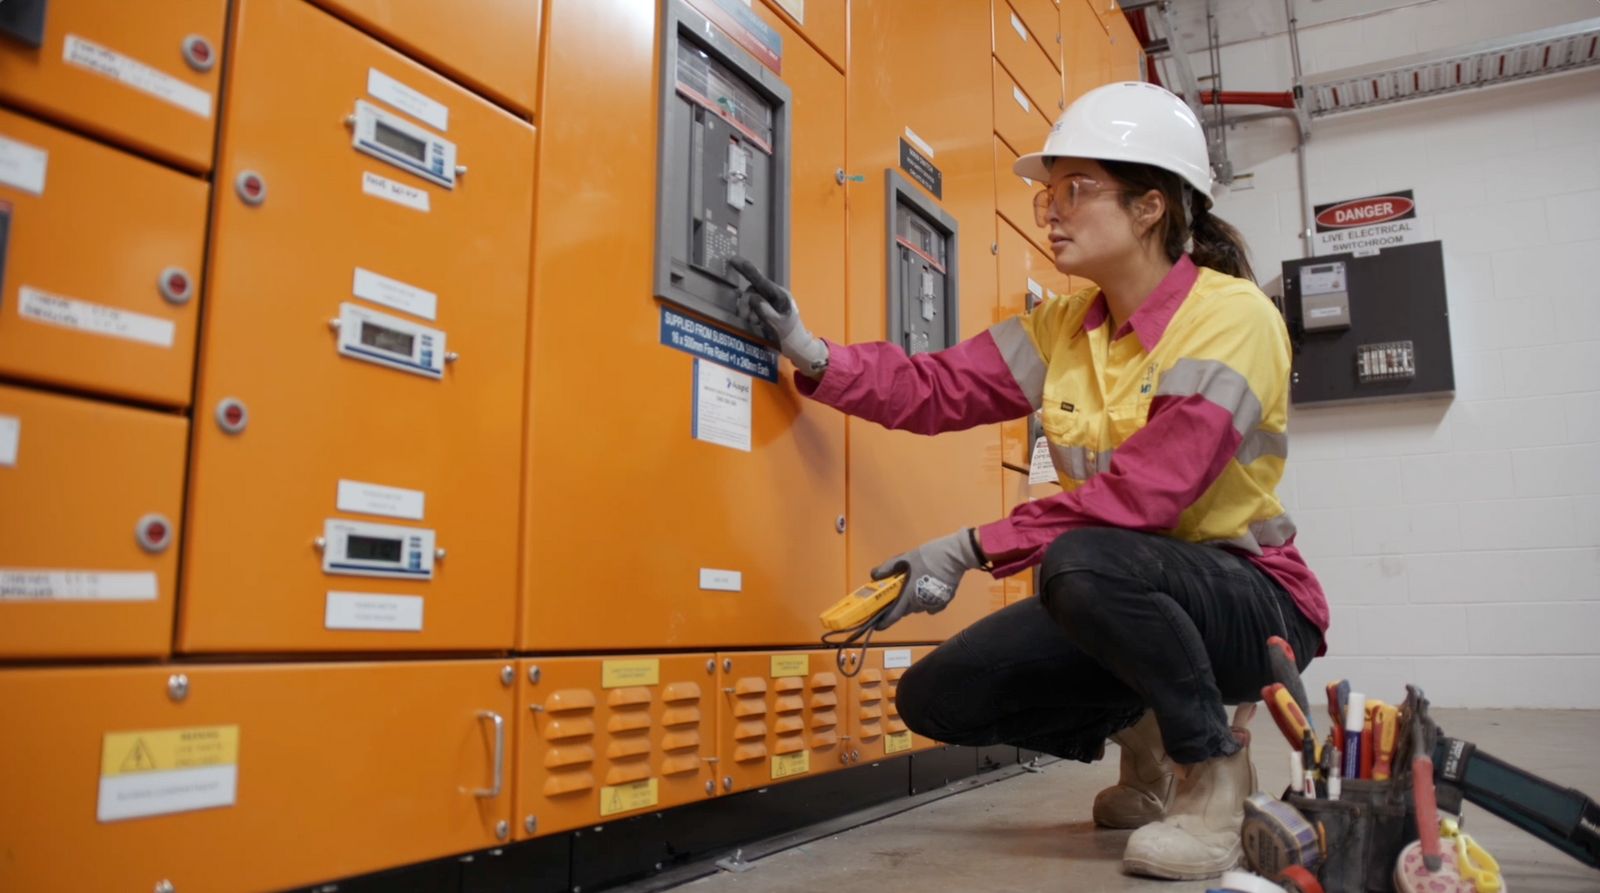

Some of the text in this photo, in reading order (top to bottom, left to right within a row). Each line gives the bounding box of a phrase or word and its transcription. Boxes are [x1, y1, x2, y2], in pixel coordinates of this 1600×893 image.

[1335, 202, 1394, 223] DANGER
[1322, 223, 1412, 243] LIVE ELECTRICAL
[1332, 236, 1404, 251] SWITCHROOM
[665, 311, 695, 333] SUPPLIED
[695, 323, 712, 338] FROM
[713, 330, 745, 352] SUBSTATION
[704, 342, 714, 357] Fire
[714, 346, 730, 362] Rated
